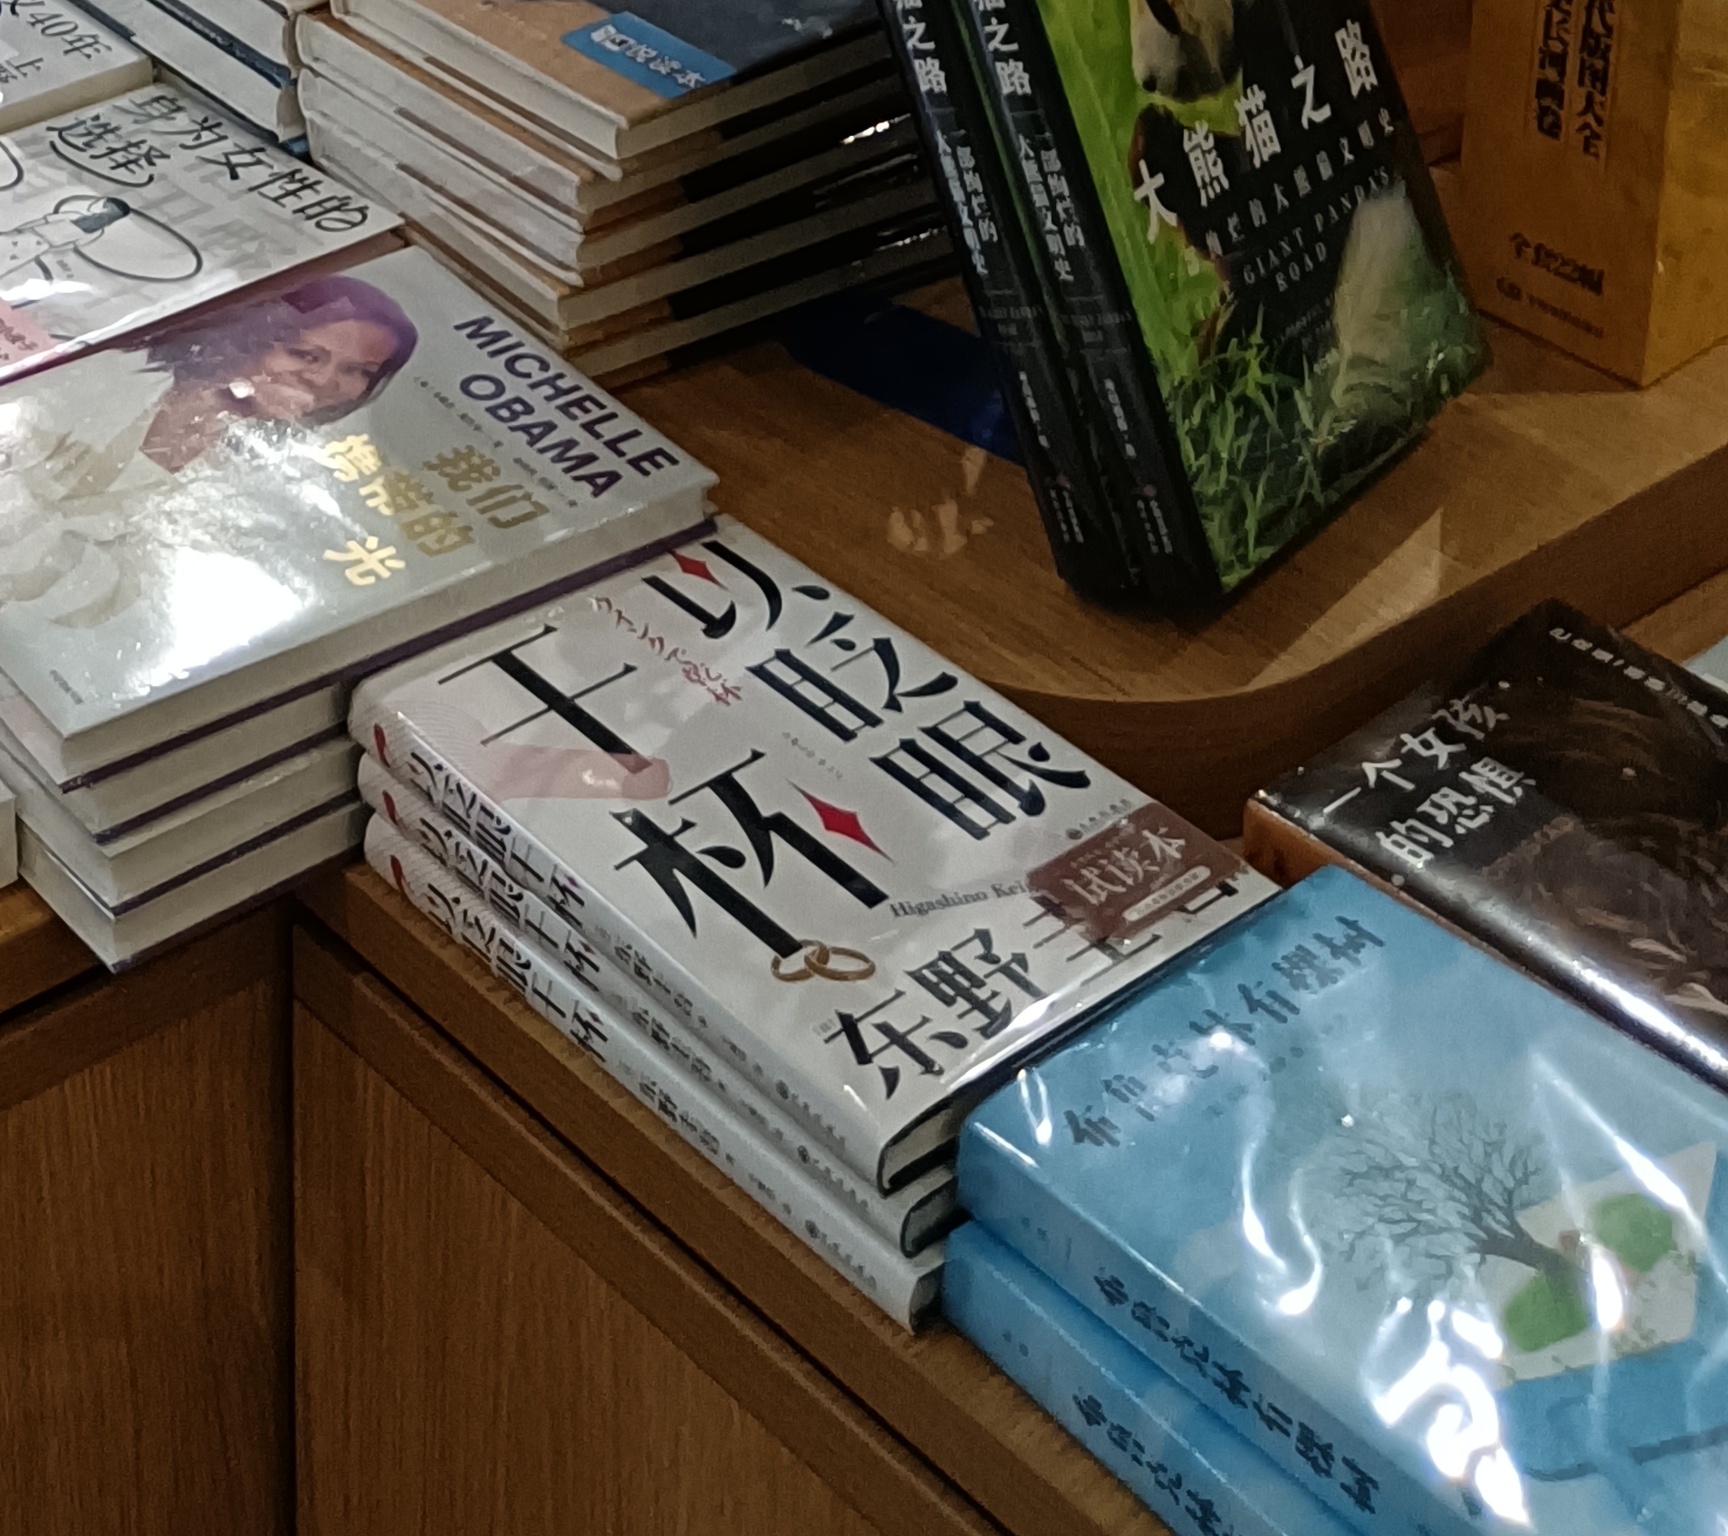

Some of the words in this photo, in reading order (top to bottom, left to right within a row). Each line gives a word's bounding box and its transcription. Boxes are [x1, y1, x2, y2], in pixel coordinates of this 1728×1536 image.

[42, 109, 178, 179] 选择
[109, 86, 384, 241] 身为女性的
[1133, 17, 1379, 244] 大熊猫之路
[1243, 233, 1310, 285] GIANT
[1314, 166, 1390, 229] PANDA'S
[1275, 241, 1328, 293] ROAD
[453, 315, 679, 477] MICHELLE
[459, 374, 623, 498] OBAMA
[320, 432, 476, 558] 携带的
[422, 444, 550, 529] 我们
[322, 536, 407, 586] 光
[641, 539, 1092, 843] 以眨眼
[437, 623, 892, 963] 干杯
[1322, 694, 1511, 817] 一个女孩
[1375, 754, 1537, 870] 的恐惧
[888, 885, 991, 920] Higashino
[1062, 825, 1191, 910] 试读本
